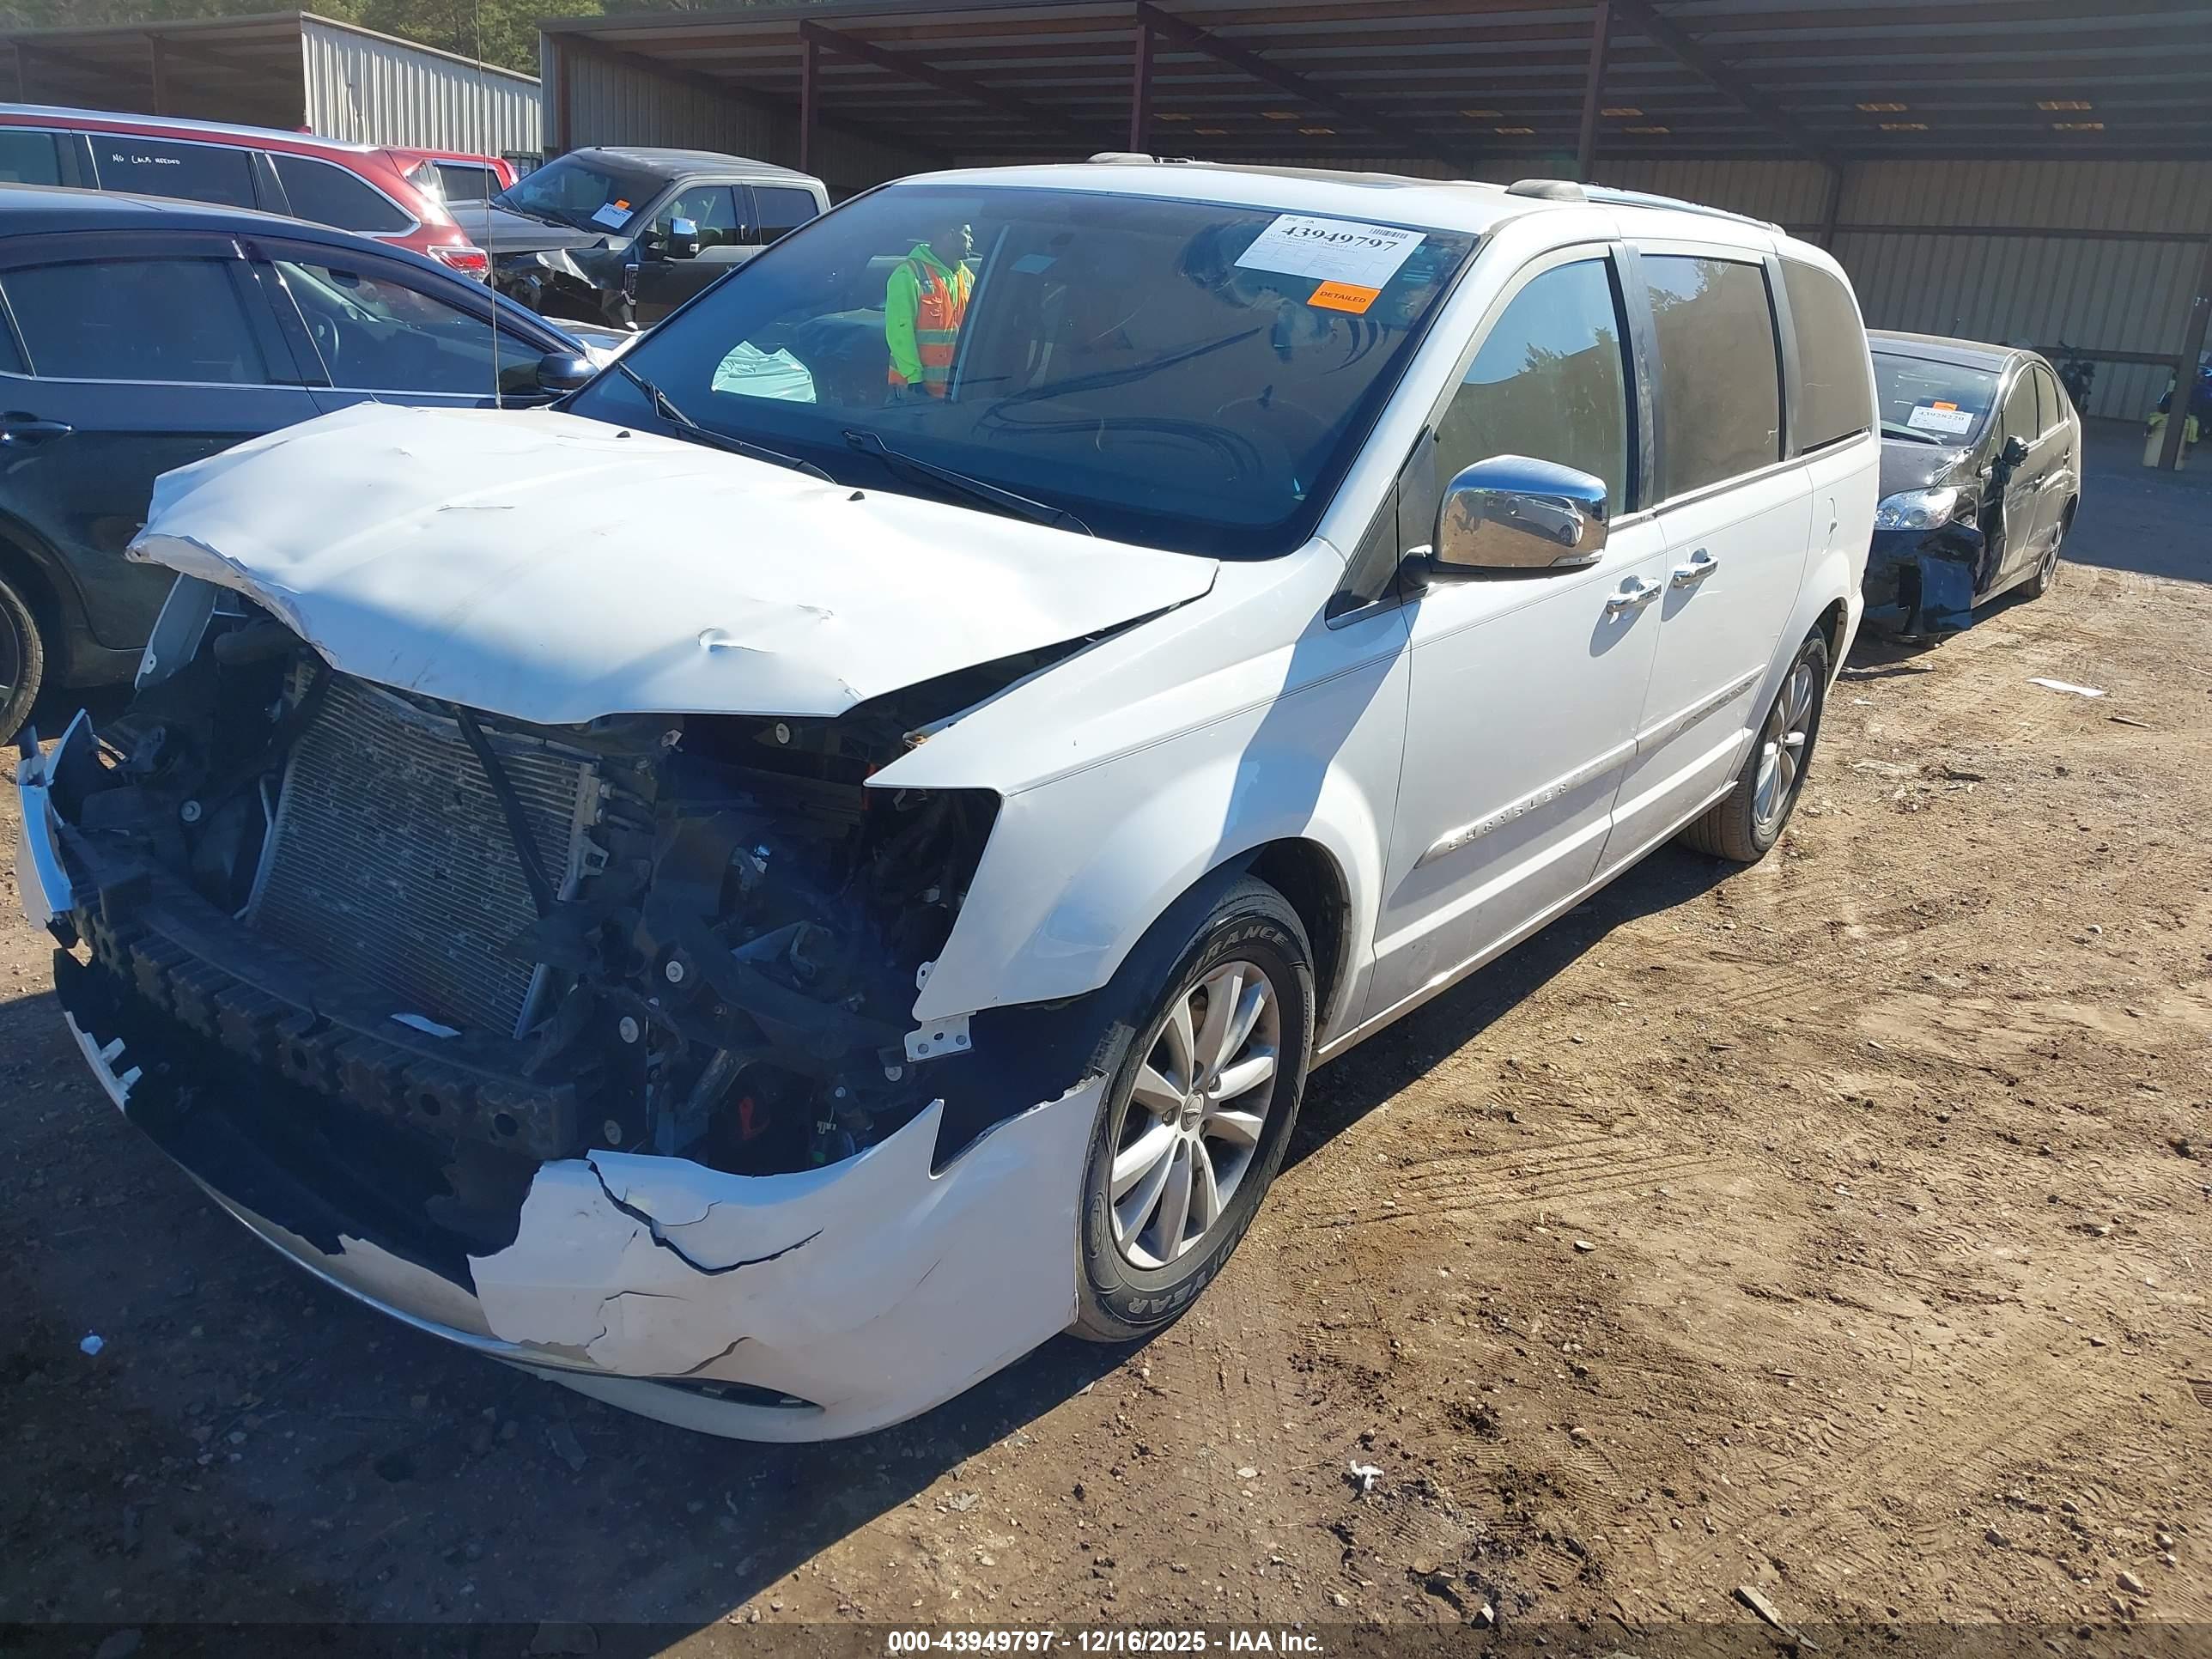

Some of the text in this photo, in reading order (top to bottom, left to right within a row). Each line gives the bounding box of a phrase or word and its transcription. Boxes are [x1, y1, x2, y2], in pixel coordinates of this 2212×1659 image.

[1281, 226, 1399, 252] 43949797
[1320, 291, 1367, 303] DETAILED
[1448, 782, 1567, 851] CHRYSLER
